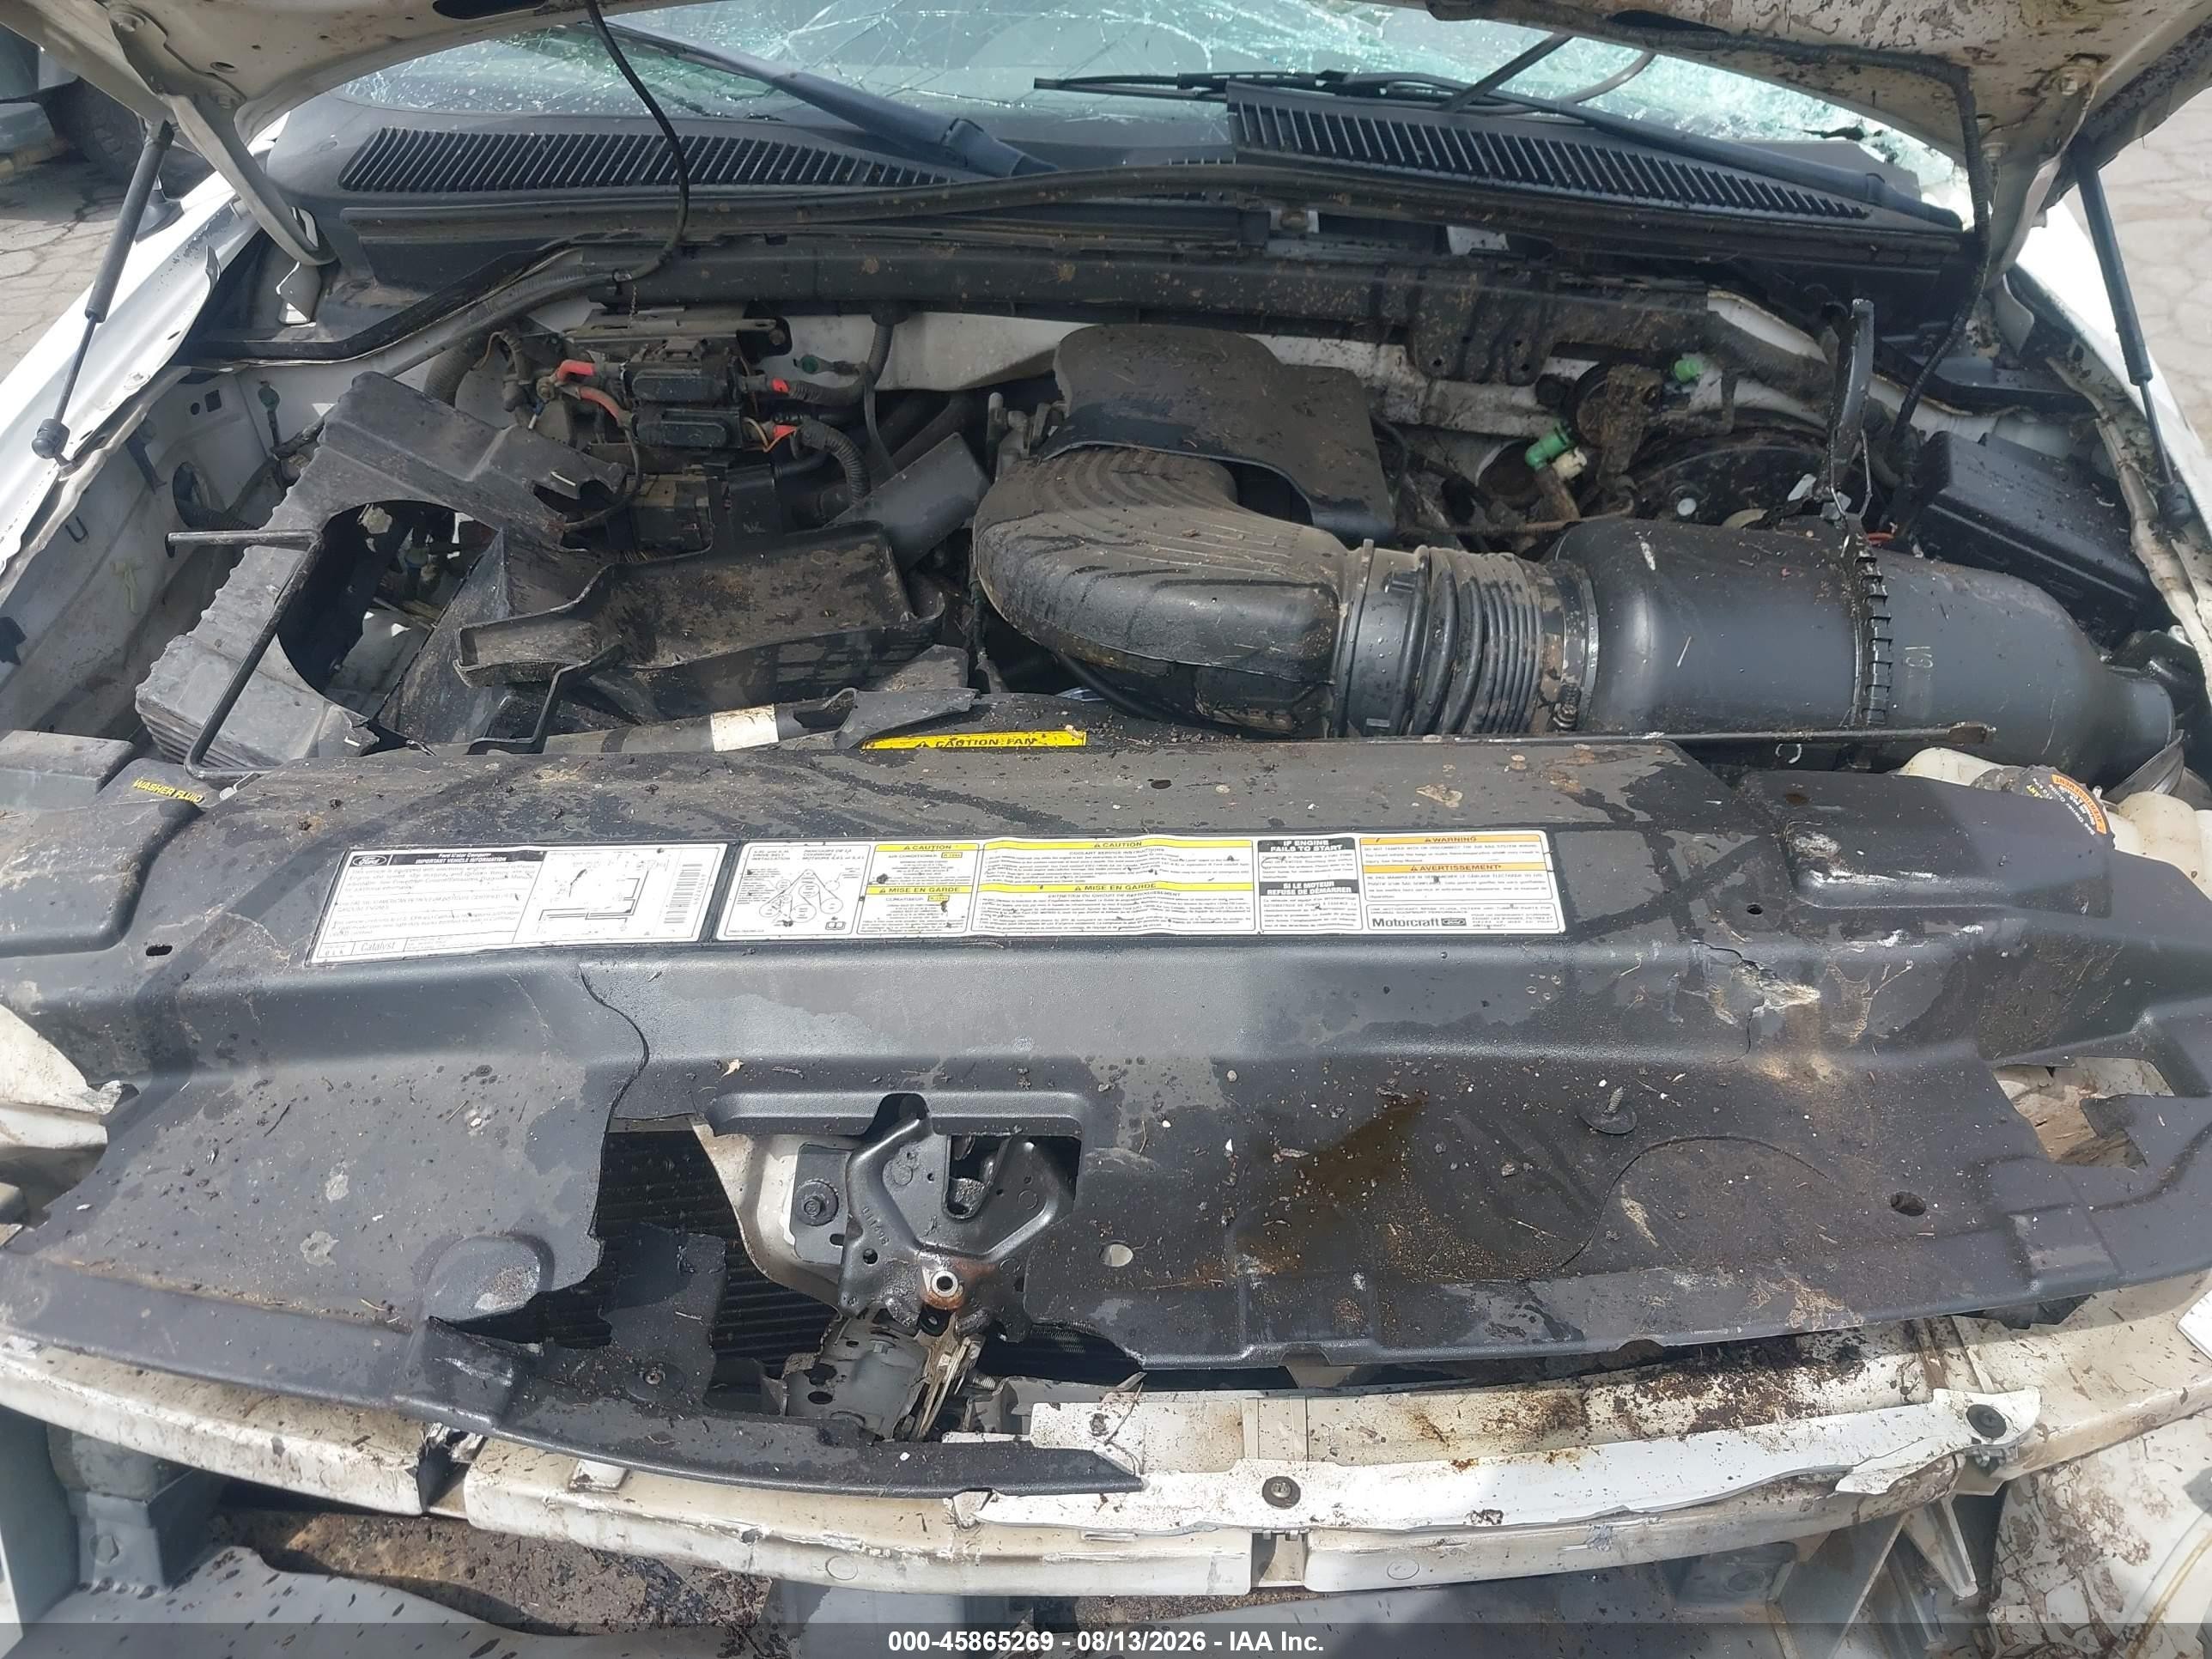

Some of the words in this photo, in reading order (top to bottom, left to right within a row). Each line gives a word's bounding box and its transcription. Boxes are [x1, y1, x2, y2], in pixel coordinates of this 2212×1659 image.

[936, 738, 999, 748] CAUTION
[1006, 738, 1036, 746] FAN
[132, 779, 175, 797] WASHER
[173, 789, 204, 805] FLUID
[2065, 803, 2084, 823] Owner
[1372, 917, 1440, 927] Motorcraft
[361, 940, 396, 952] Catalyst
